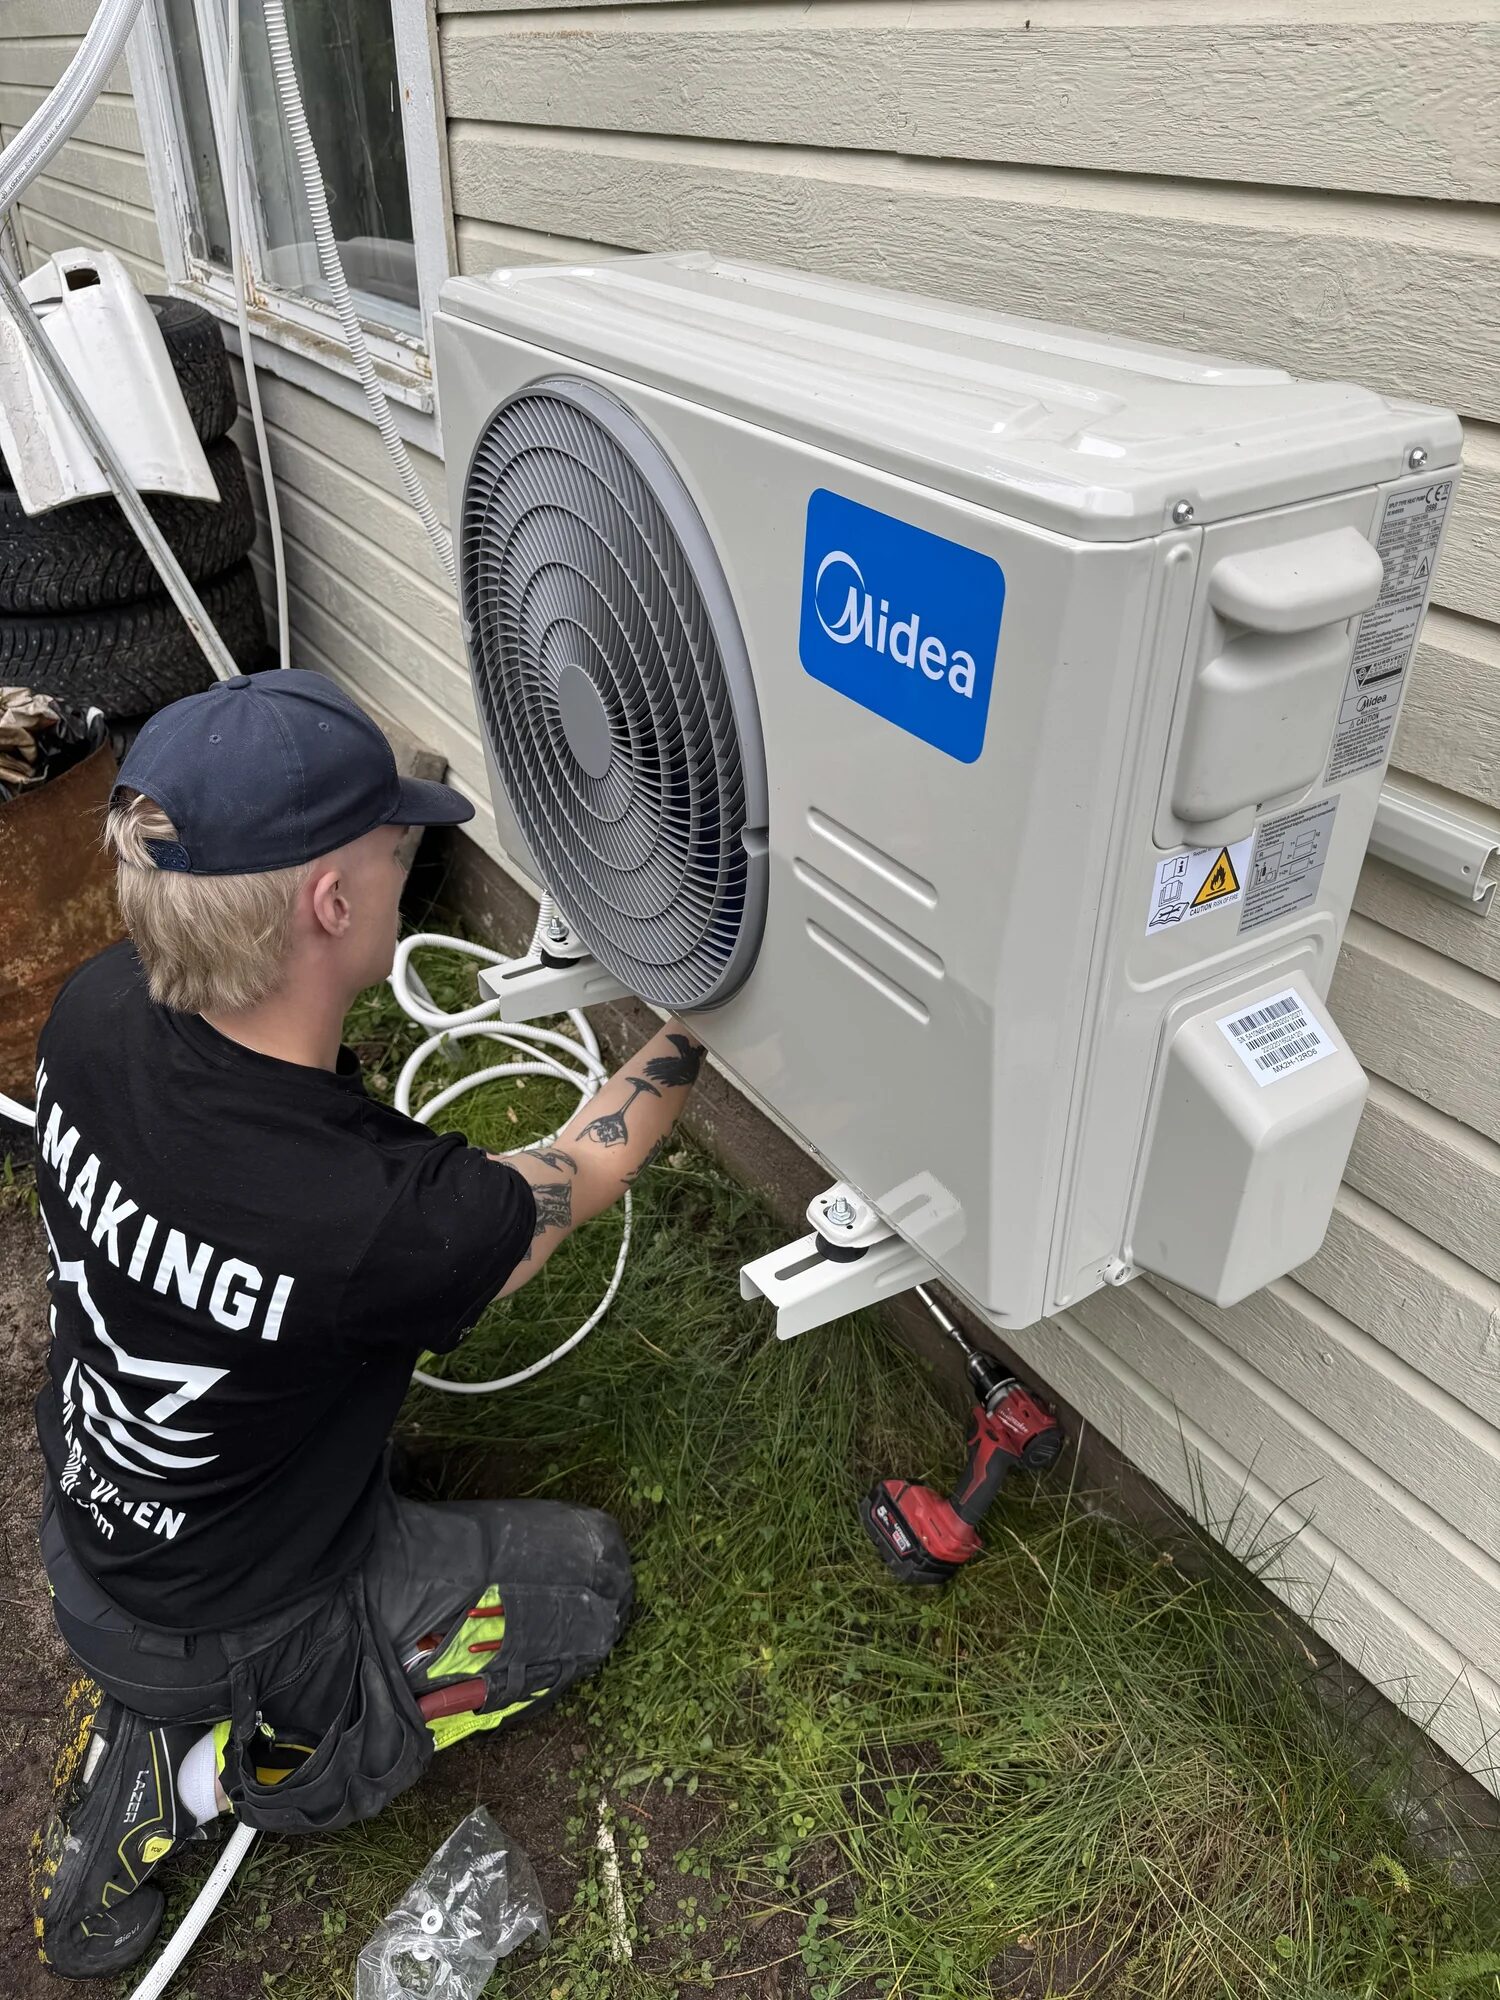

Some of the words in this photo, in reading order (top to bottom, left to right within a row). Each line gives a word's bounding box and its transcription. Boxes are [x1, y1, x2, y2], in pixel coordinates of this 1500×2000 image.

[815, 550, 976, 699] Midea
[1356, 694, 1387, 712] Midea
[1189, 902, 1213, 917] CAUTION
[123, 1769, 150, 1824] LAZER
[113, 1923, 141, 1948] Sievi
